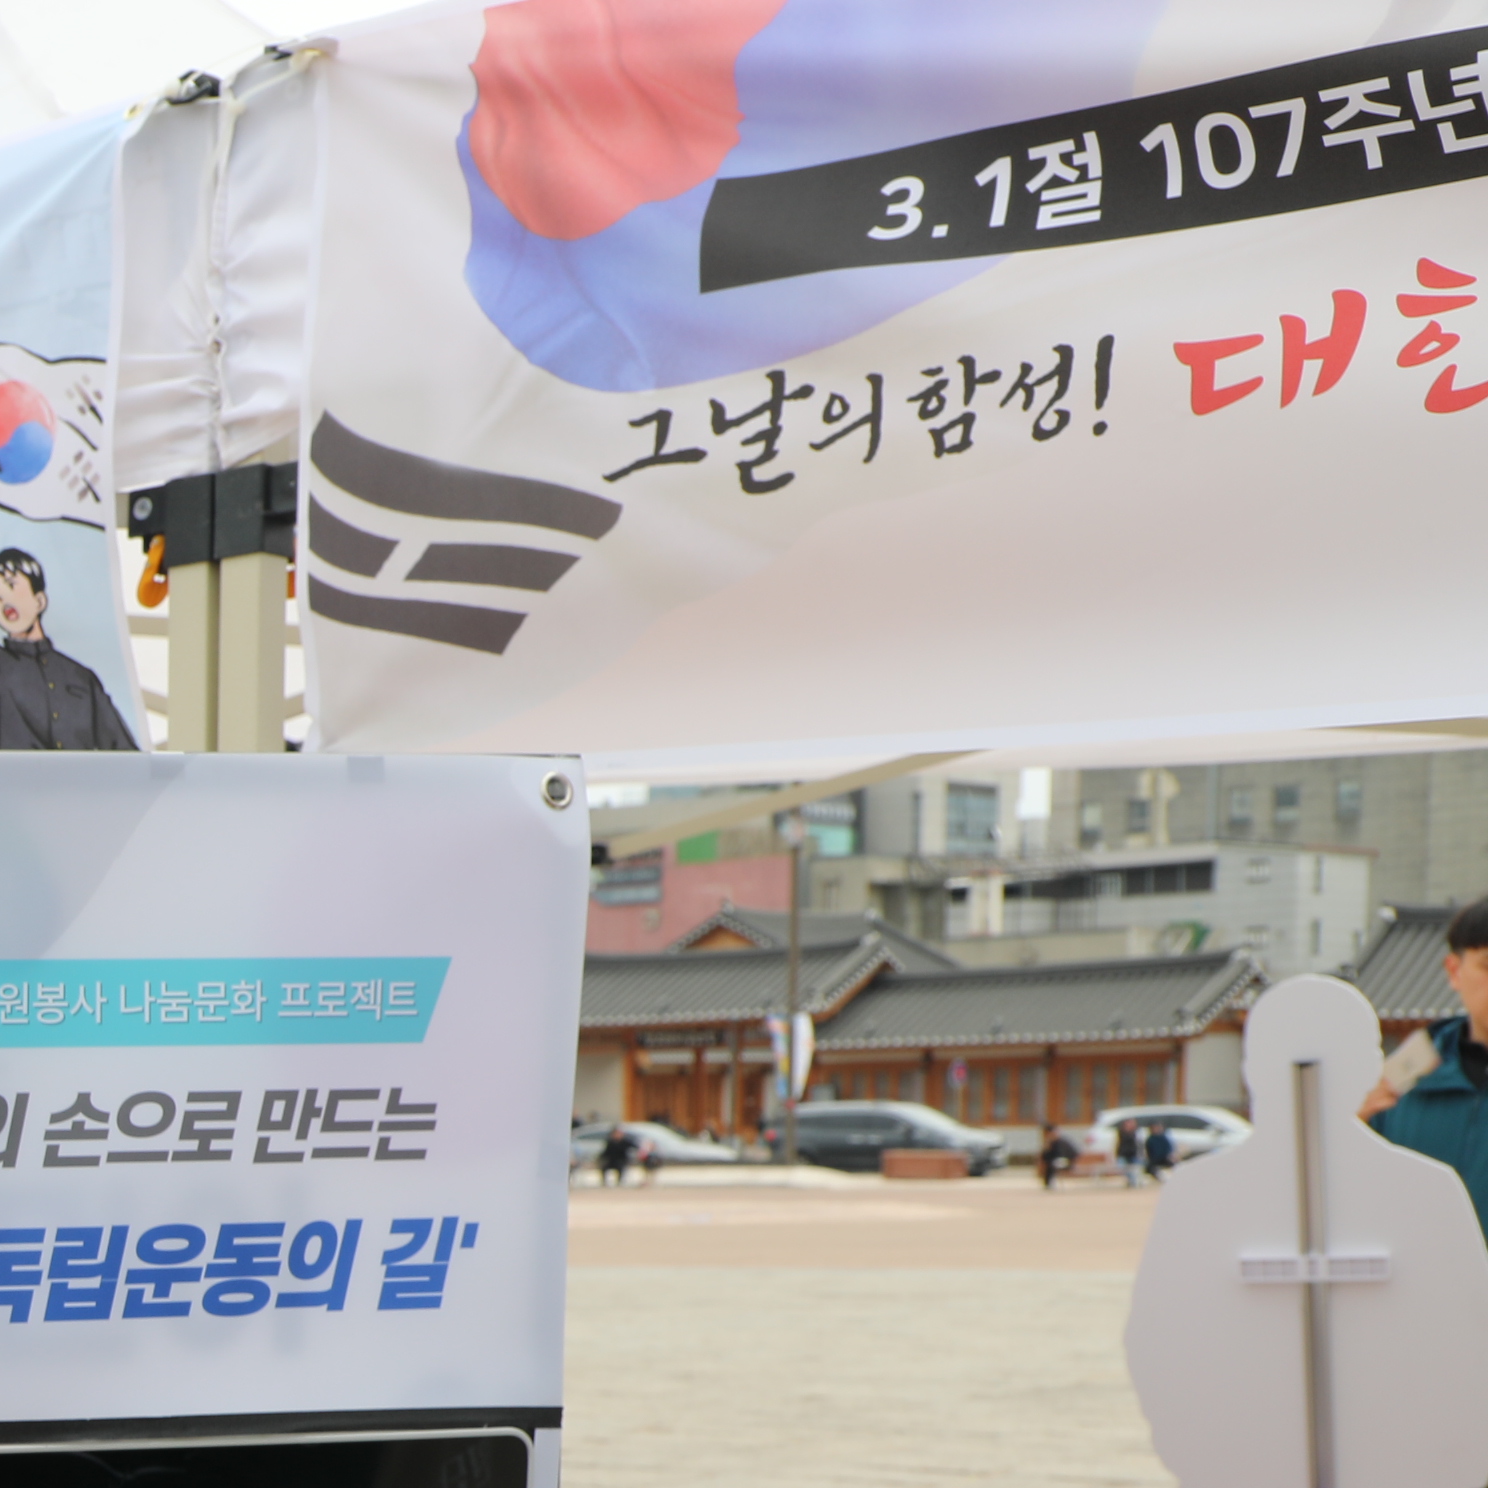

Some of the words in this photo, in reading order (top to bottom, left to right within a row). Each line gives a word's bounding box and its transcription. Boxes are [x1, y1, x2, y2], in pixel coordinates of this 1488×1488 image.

[601, 368, 884, 494] 그날의
[906, 334, 1115, 460] 함성!
[119, 979, 267, 1024] 나눔문화
[279, 977, 420, 1020] 프로젝트
[42, 1090, 242, 1168] 손으로
[253, 1087, 438, 1164] 만드는
